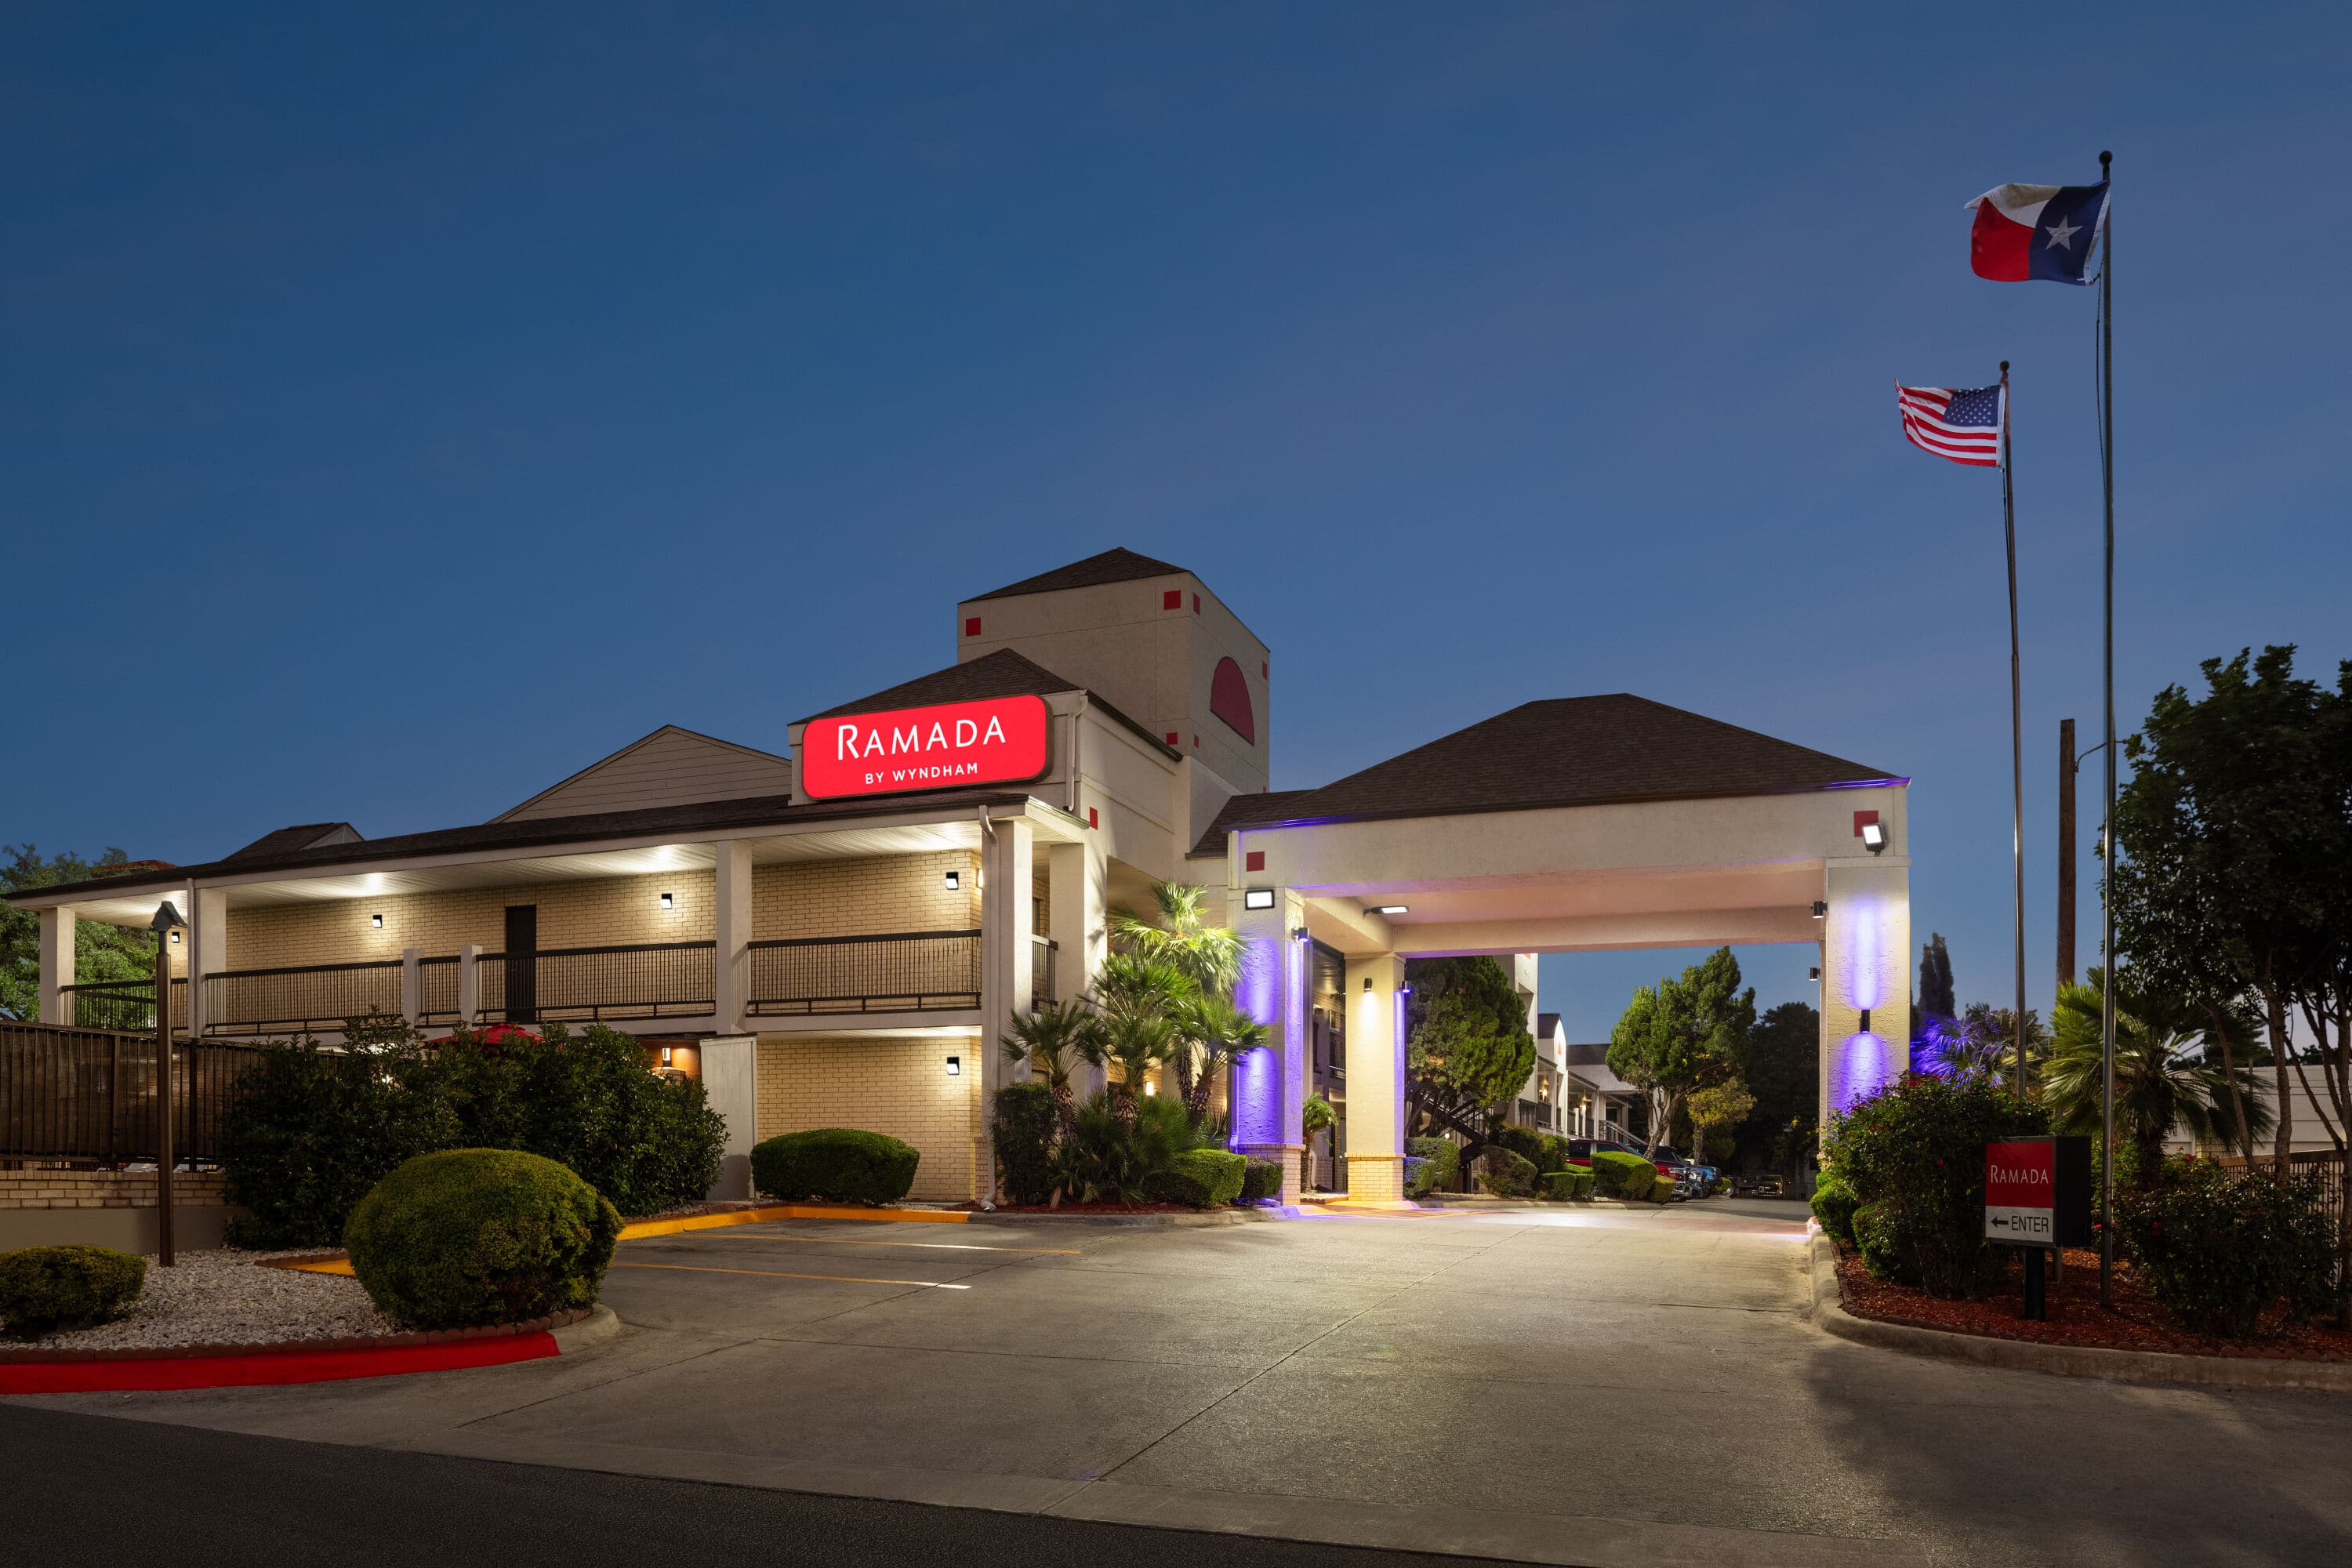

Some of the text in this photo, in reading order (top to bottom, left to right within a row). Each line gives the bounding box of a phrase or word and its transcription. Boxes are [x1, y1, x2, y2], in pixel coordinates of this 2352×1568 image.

[837, 715, 1006, 760] RAMADA
[865, 762, 978, 784] BY WYNDHAM
[1991, 1164, 2049, 1184] RAMADA
[2011, 1215, 2049, 1233] ENTER
